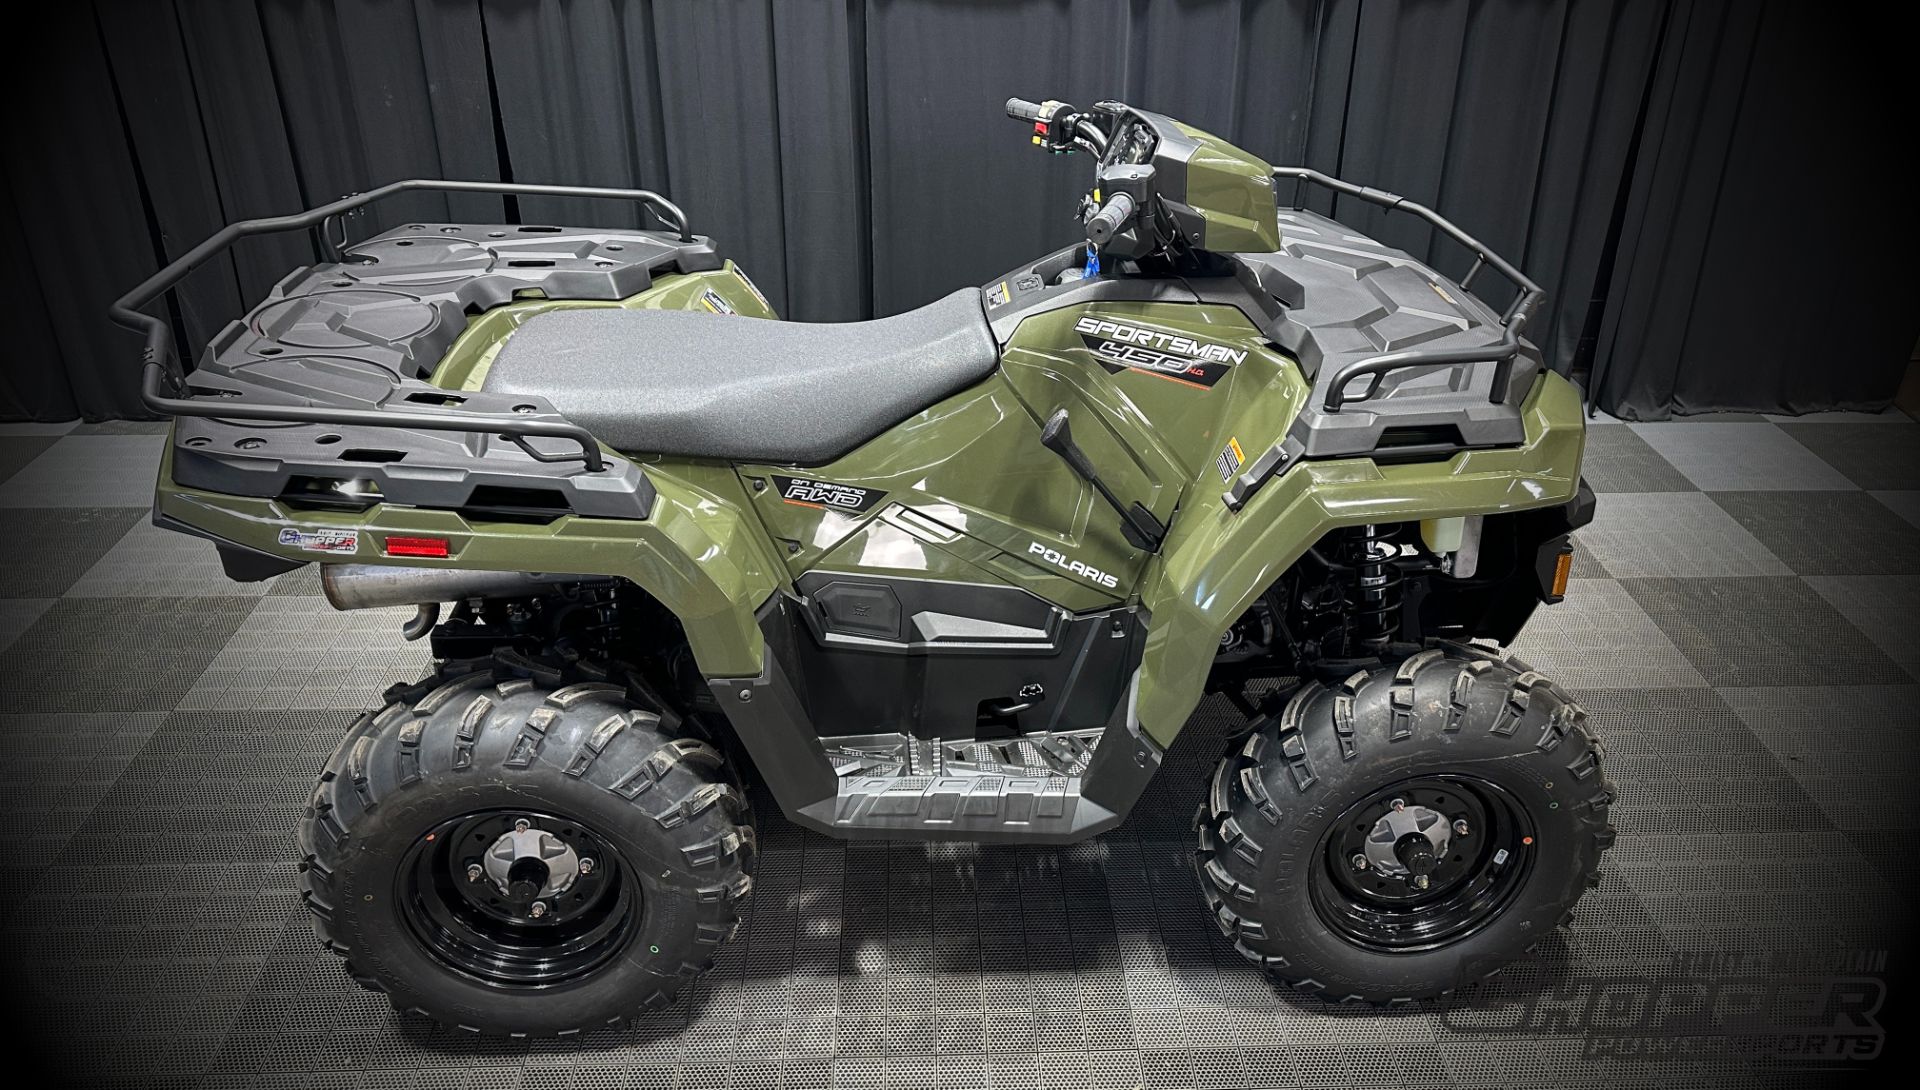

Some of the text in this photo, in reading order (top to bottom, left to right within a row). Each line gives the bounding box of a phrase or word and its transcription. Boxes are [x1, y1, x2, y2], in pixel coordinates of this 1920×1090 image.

[1076, 317, 1249, 365] SPORTSMAN
[1099, 342, 1193, 374] 450
[785, 485, 863, 508] AWD
[791, 479, 866, 495] ON DEMAND
[1028, 541, 1119, 588] POLARIS
